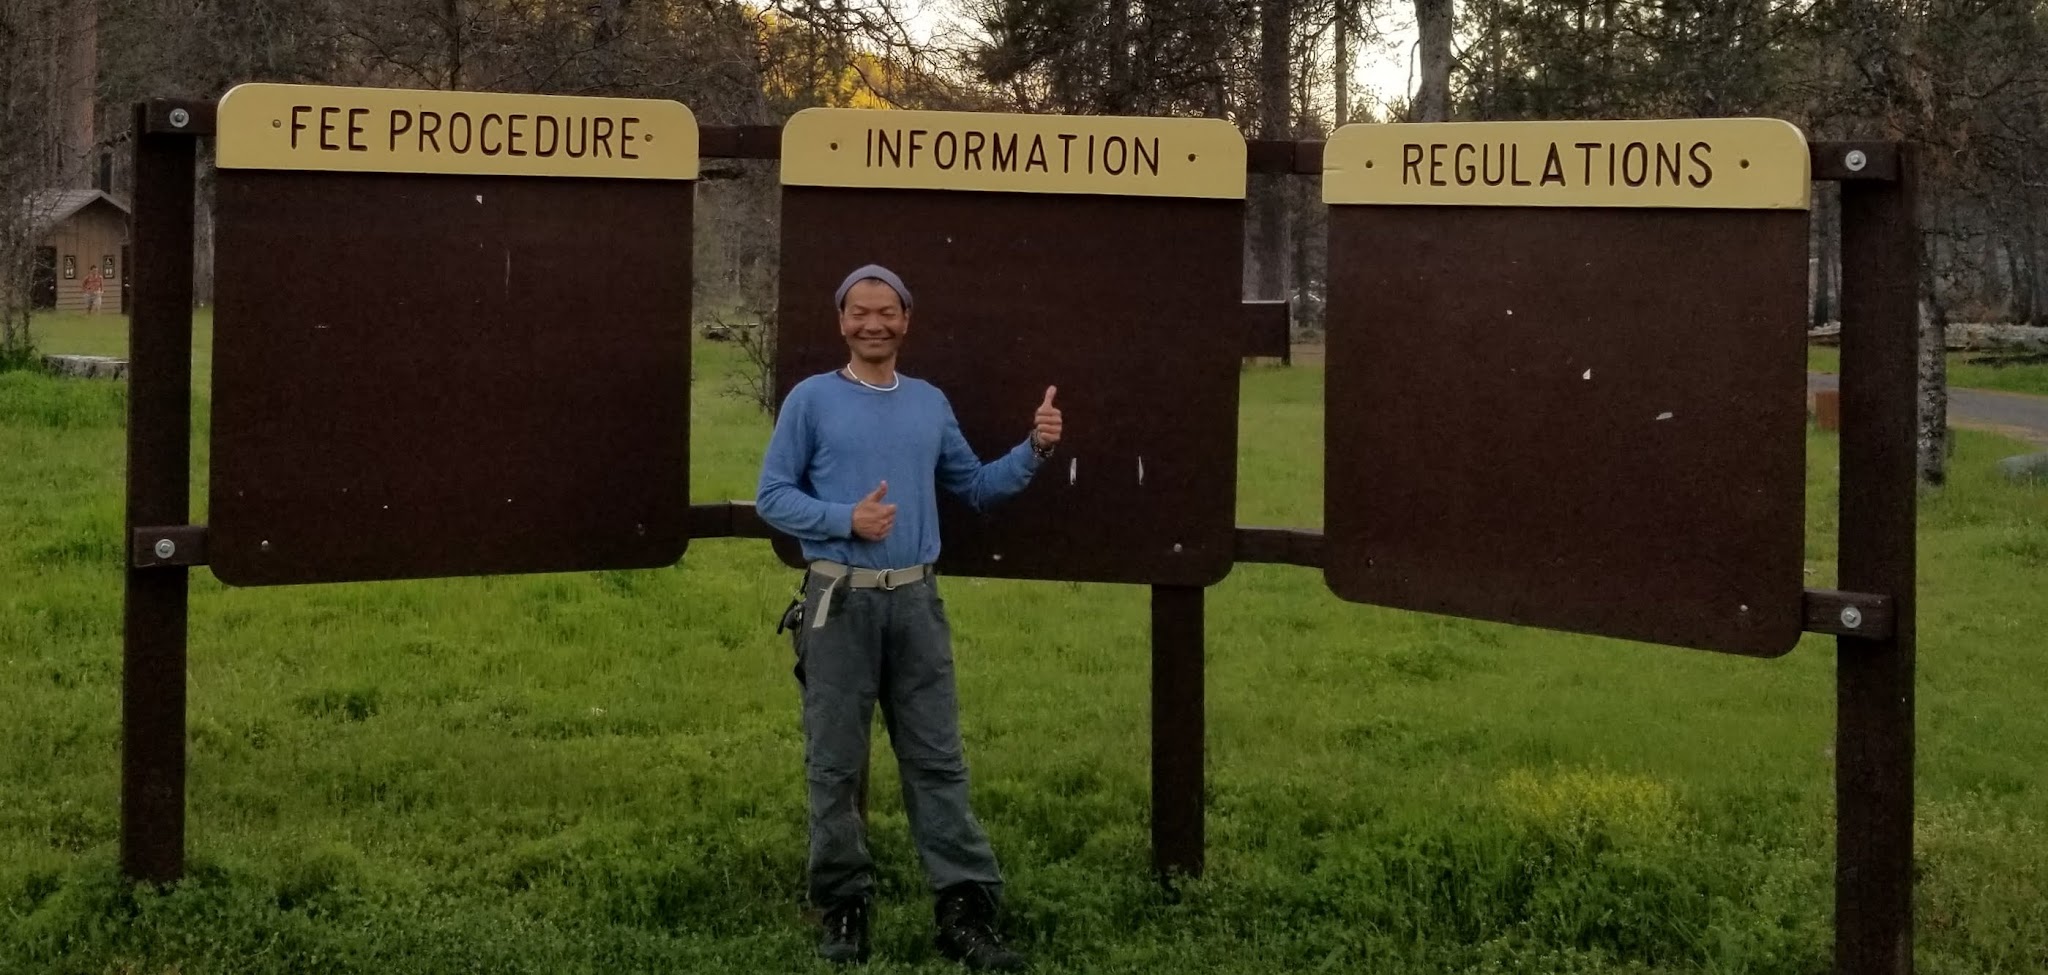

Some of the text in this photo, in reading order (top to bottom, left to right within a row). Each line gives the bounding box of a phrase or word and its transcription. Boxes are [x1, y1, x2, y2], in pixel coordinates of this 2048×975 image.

[290, 104, 641, 160] FEE PROCEDURE
[865, 127, 1159, 177] INFORMATION
[1401, 141, 1713, 189] REGULATIONS
